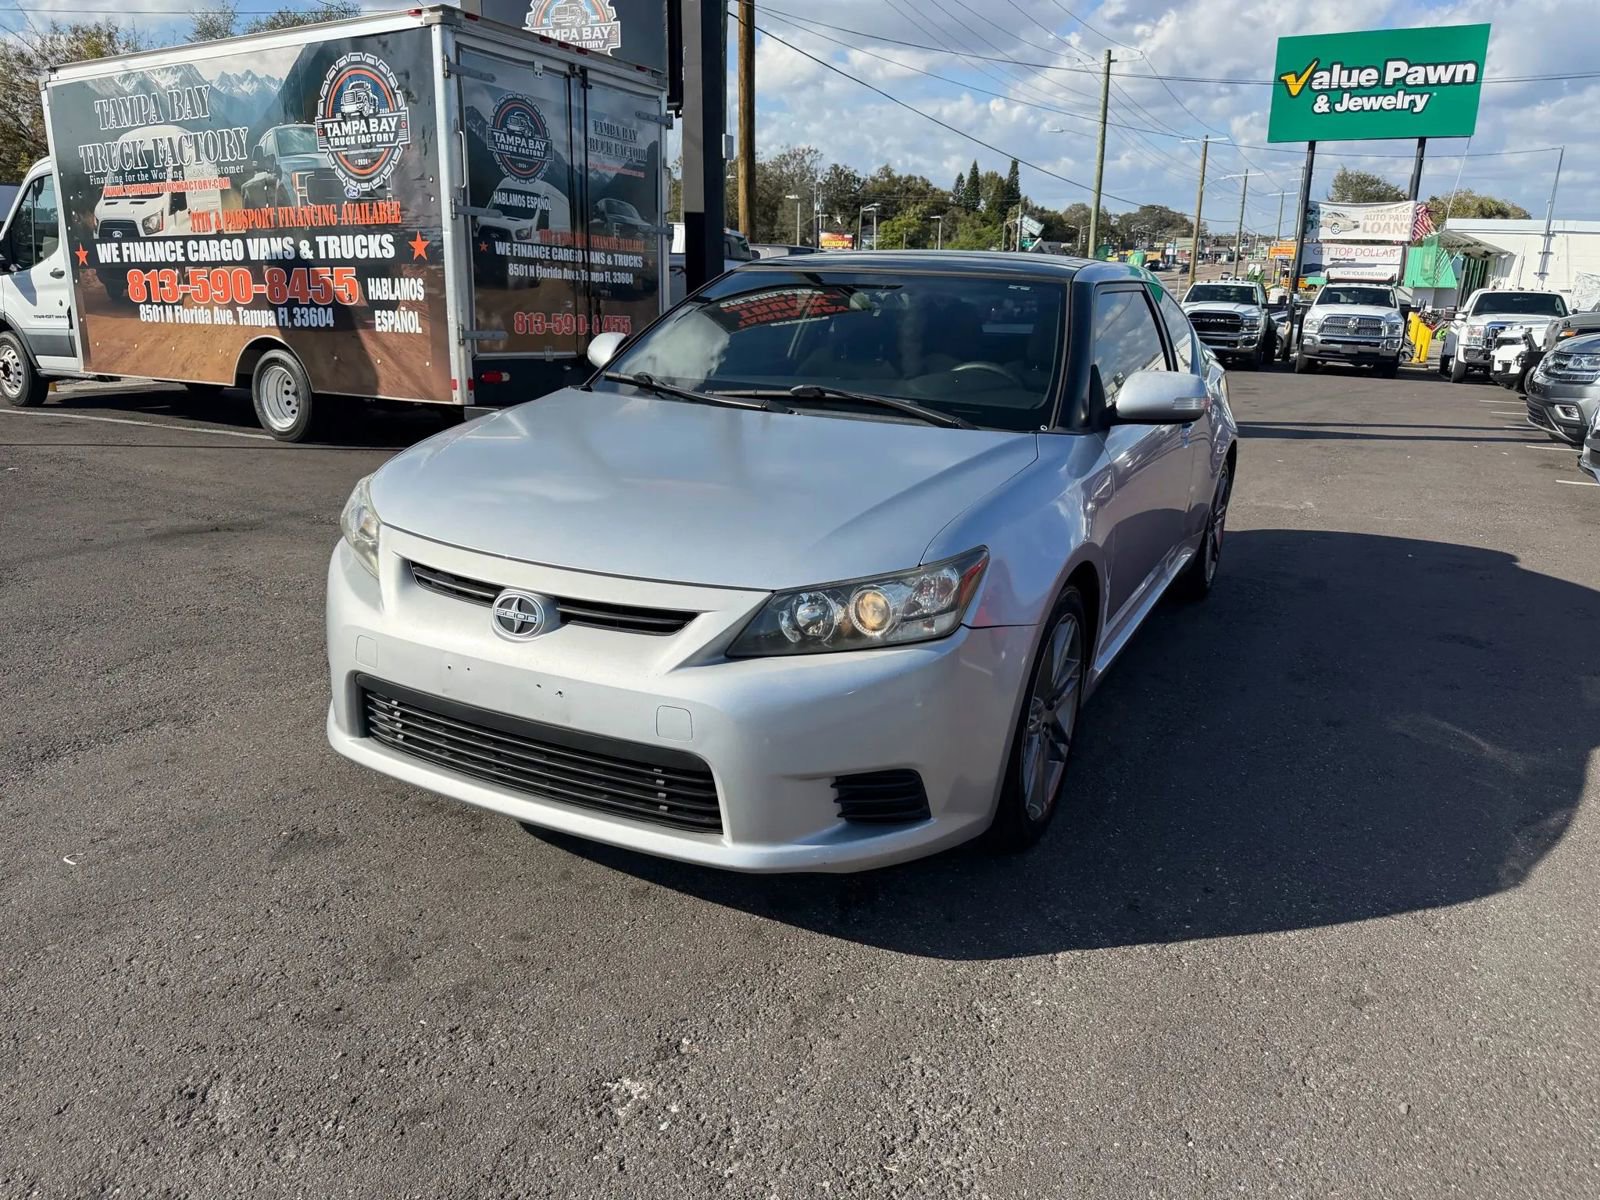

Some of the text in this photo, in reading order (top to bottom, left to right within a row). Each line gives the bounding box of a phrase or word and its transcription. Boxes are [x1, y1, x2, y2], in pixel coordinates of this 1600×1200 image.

[582, 26, 611, 40] BAY
[1384, 60, 1476, 86] Pawn
[94, 85, 210, 130] TAMPA BAY
[1313, 91, 1430, 113] & Jewelry
[324, 116, 398, 137] TAMPA BAY
[78, 127, 248, 174] TRUCK FACTORY
[329, 132, 395, 147] TRUCK FACTORY
[493, 132, 547, 152] TAMPA BAY
[497, 142, 544, 158] TRUCK FACTORY
[125, 171, 136, 183] for
[136, 171, 149, 182] the
[493, 191, 526, 208] HABLAMOS
[223, 207, 275, 231] PASSPORT
[277, 204, 338, 228] FINANCING
[340, 201, 402, 226] AVAILABLE
[1363, 213, 1387, 221] AUTO
[1362, 221, 1412, 235] LOANS
[96, 233, 396, 264] WE FINANCE CARGO VANS & TRUCKS
[495, 241, 512, 256] WE
[513, 243, 551, 259] FINANCE
[552, 247, 583, 263] CARGO
[606, 254, 613, 265] &
[613, 253, 643, 268] TRUCKS
[1312, 246, 1397, 258] GET TOP DOLLAR
[508, 263, 529, 277] 8501
[529, 265, 535, 277] N
[536, 264, 562, 280] Florida
[612, 272, 634, 285] 33604
[127, 267, 360, 306] 813-590-8455
[367, 277, 425, 301] HABLAMOS
[139, 303, 165, 323] 8501
[165, 305, 174, 323] N
[174, 305, 211, 325] Florida
[213, 306, 236, 326] Ave.
[236, 306, 276, 328] Tampa
[293, 307, 335, 328] 33604
[374, 307, 422, 333] ESPAÑOL
[514, 311, 632, 337] 813-590-8455
